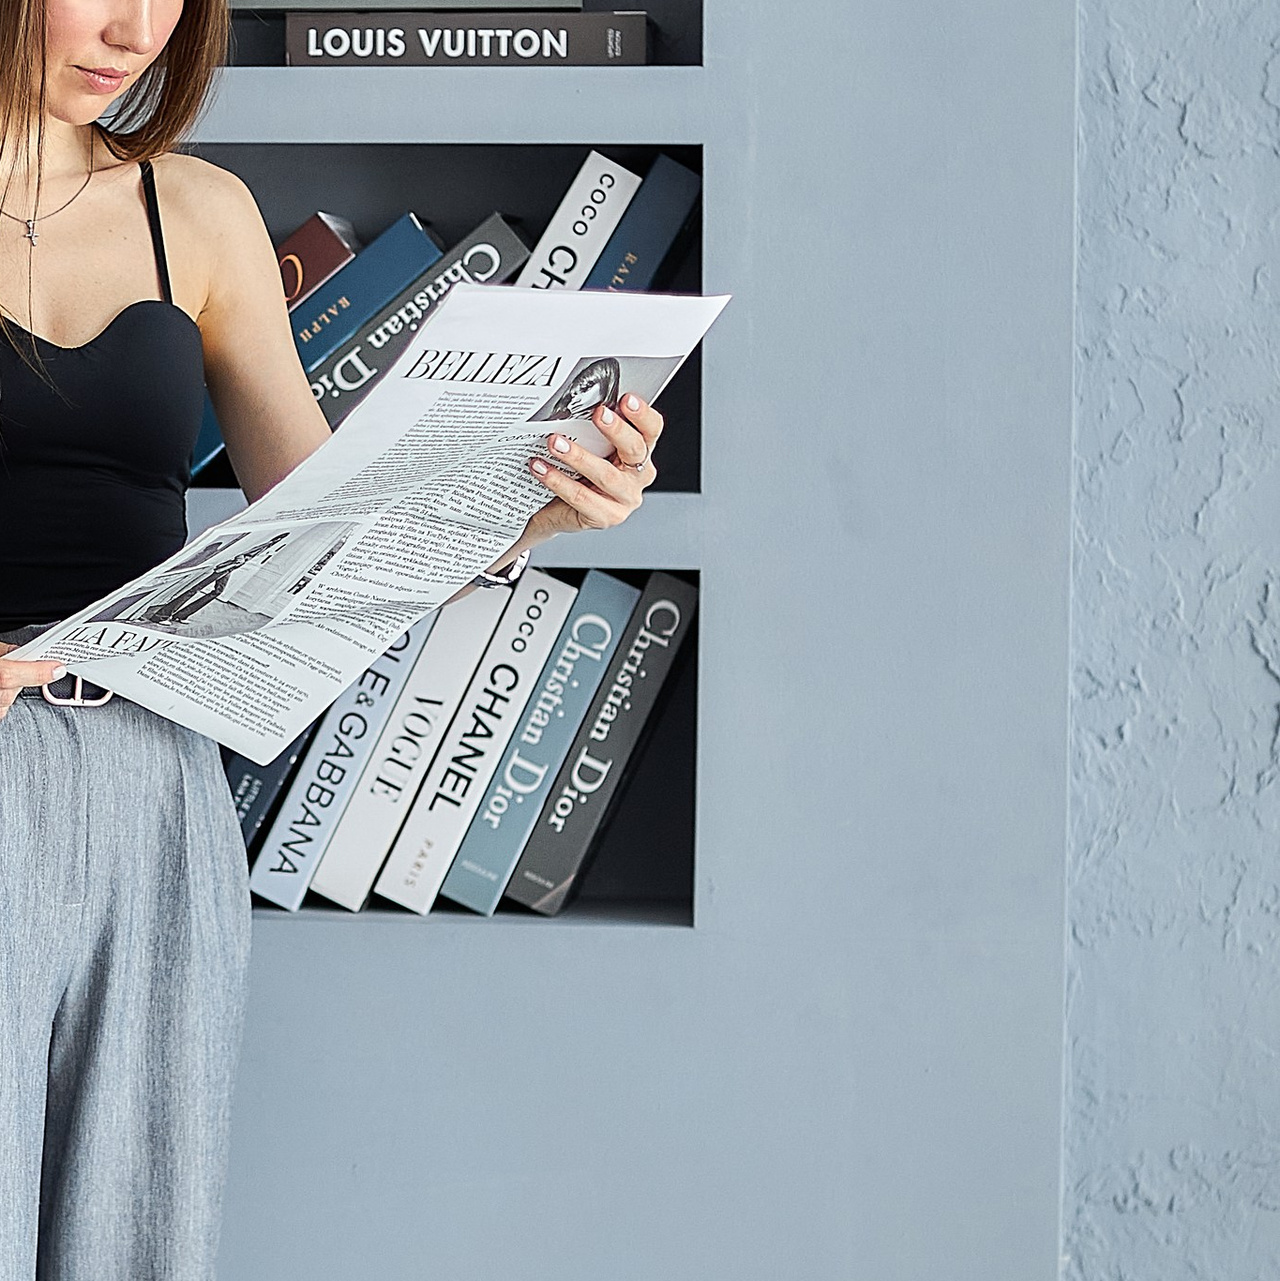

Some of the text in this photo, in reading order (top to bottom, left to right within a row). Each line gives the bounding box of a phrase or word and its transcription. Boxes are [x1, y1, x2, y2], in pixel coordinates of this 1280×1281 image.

[307, 28, 568, 58] LOUIS VUITTON
[572, 173, 615, 236] COCO
[299, 296, 351, 343] RALPH
[366, 243, 501, 349] Christian
[310, 346, 378, 400] Dio
[401, 349, 562, 387] BELLEZA
[370, 695, 443, 804] VOGUE
[404, 588, 549, 890] COCO CHANEL PARIS
[483, 612, 612, 829] Christian Dior
[548, 599, 681, 833] Christian Dior
[270, 712, 368, 877] GABBANA
